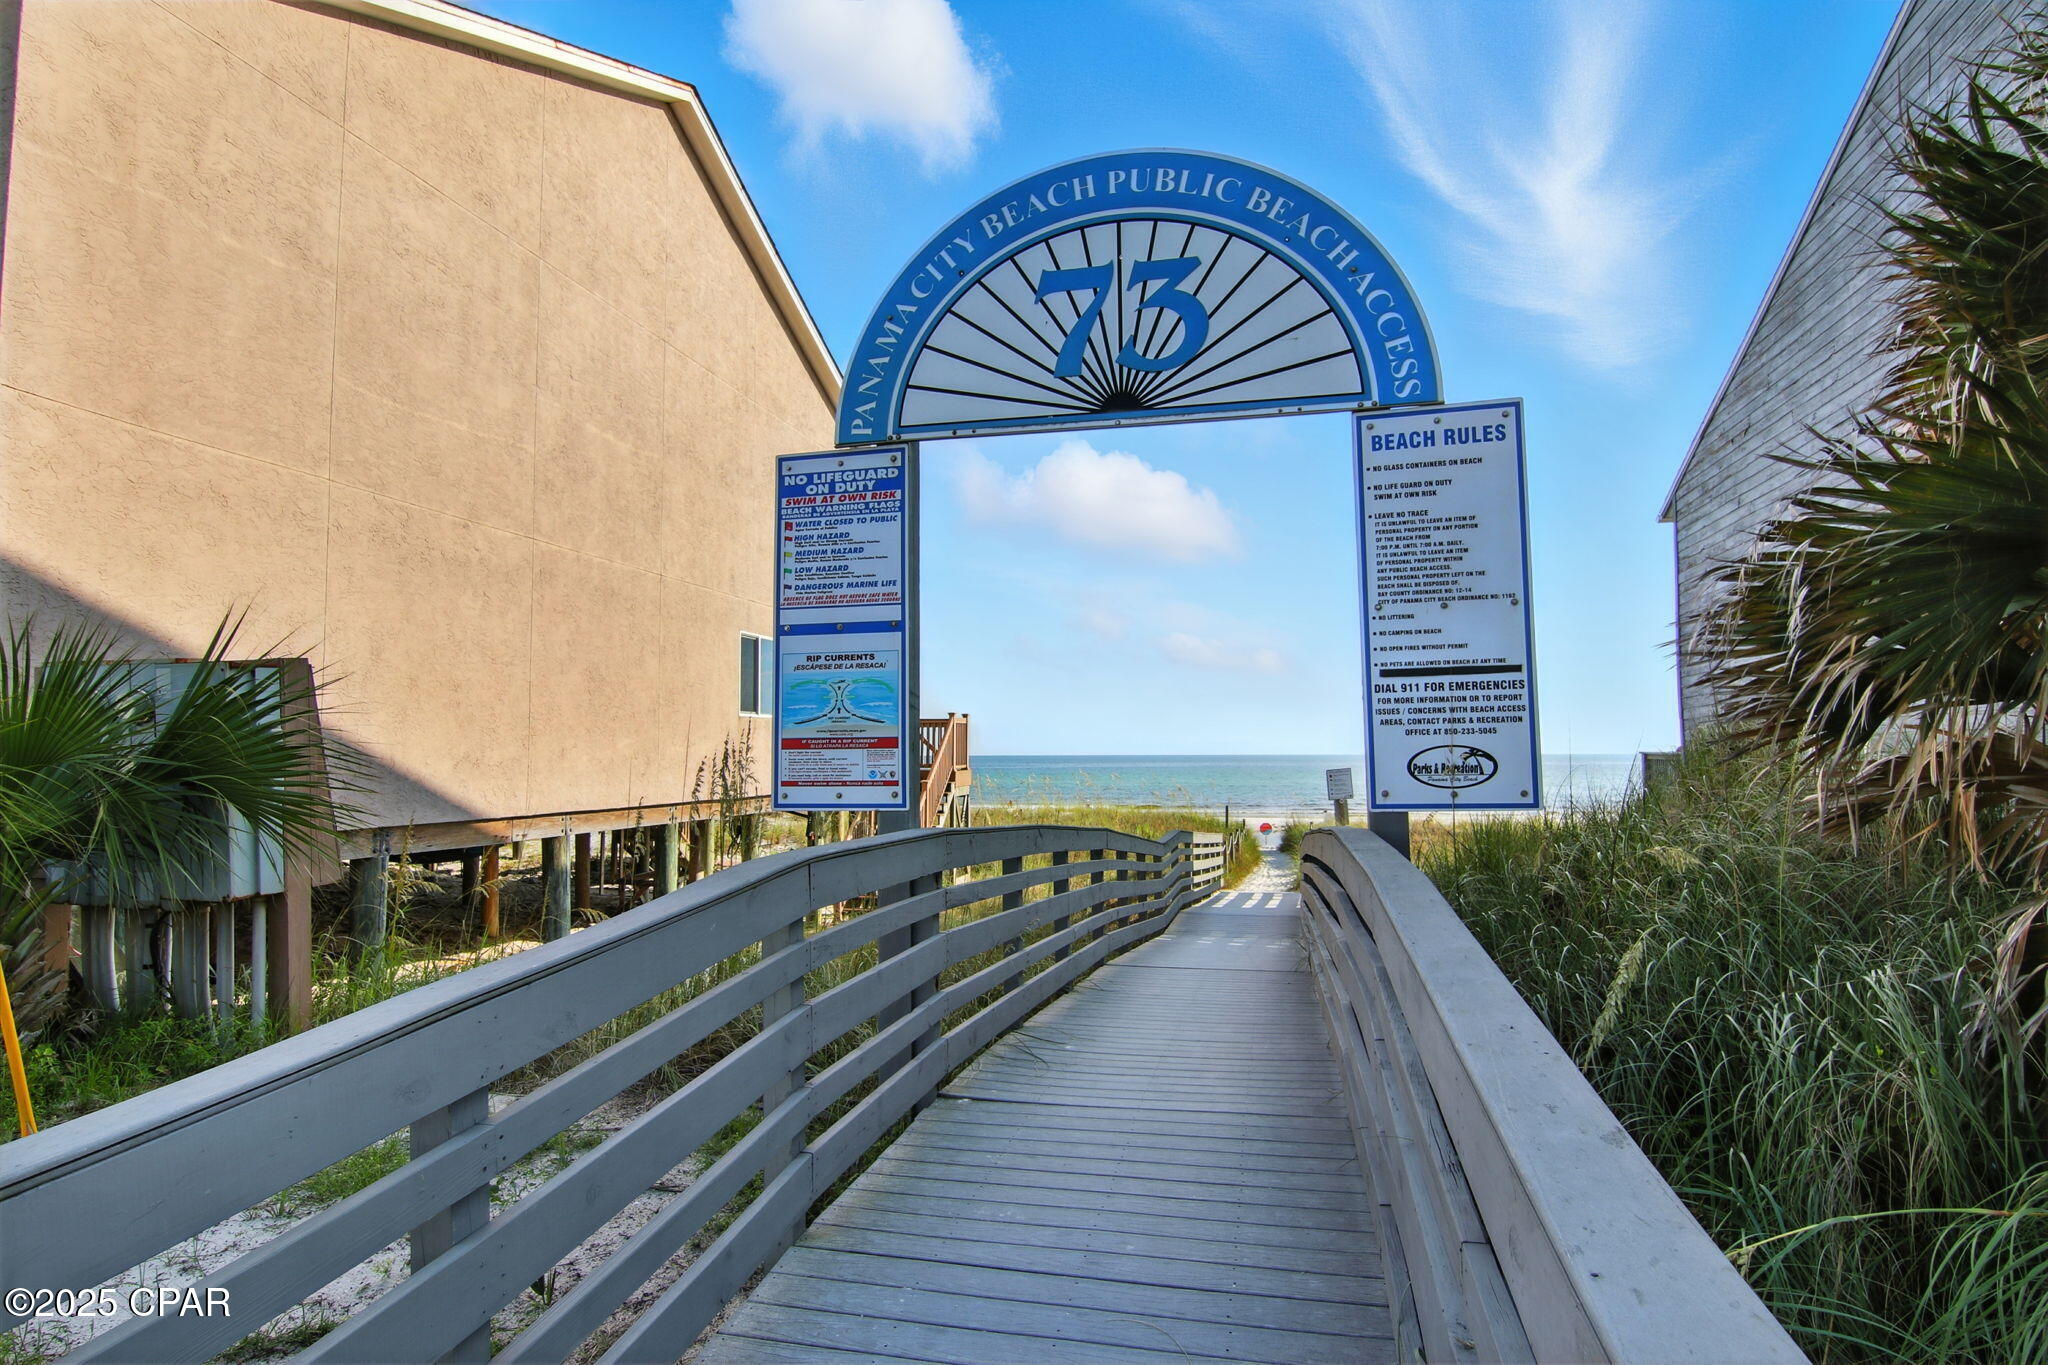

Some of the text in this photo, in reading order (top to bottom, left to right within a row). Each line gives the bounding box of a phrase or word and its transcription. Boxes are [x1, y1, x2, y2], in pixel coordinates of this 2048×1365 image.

[851, 168, 1422, 436] PANAMA CITY BEACH PUBLIC BEACH ACCESS
[1034, 256, 1209, 378] 73
[1372, 424, 1506, 452] BEACH RULES
[1406, 460, 1446, 469] CONTAINERS
[1460, 458, 1482, 466] BEACH
[785, 468, 898, 486] NO LIFEGUARD
[806, 480, 876, 494] ON DUTY
[786, 491, 896, 506] SWIM AT OWN RISK
[816, 504, 865, 512] WARNING
[796, 520, 821, 528] WATER
[825, 518, 853, 526] CLOSED
[870, 515, 897, 523] PUBLIC
[817, 532, 849, 540] HAZARD
[831, 547, 864, 555] HAZARD
[794, 664, 832, 672] ¡ESCÁPESE
[1374, 680, 1524, 693] DIAL 911 FOR EMERGENCIES
[1494, 694, 1522, 702] REPORT
[1413, 763, 1432, 774] Parks
[1434, 763, 1440, 773] &
